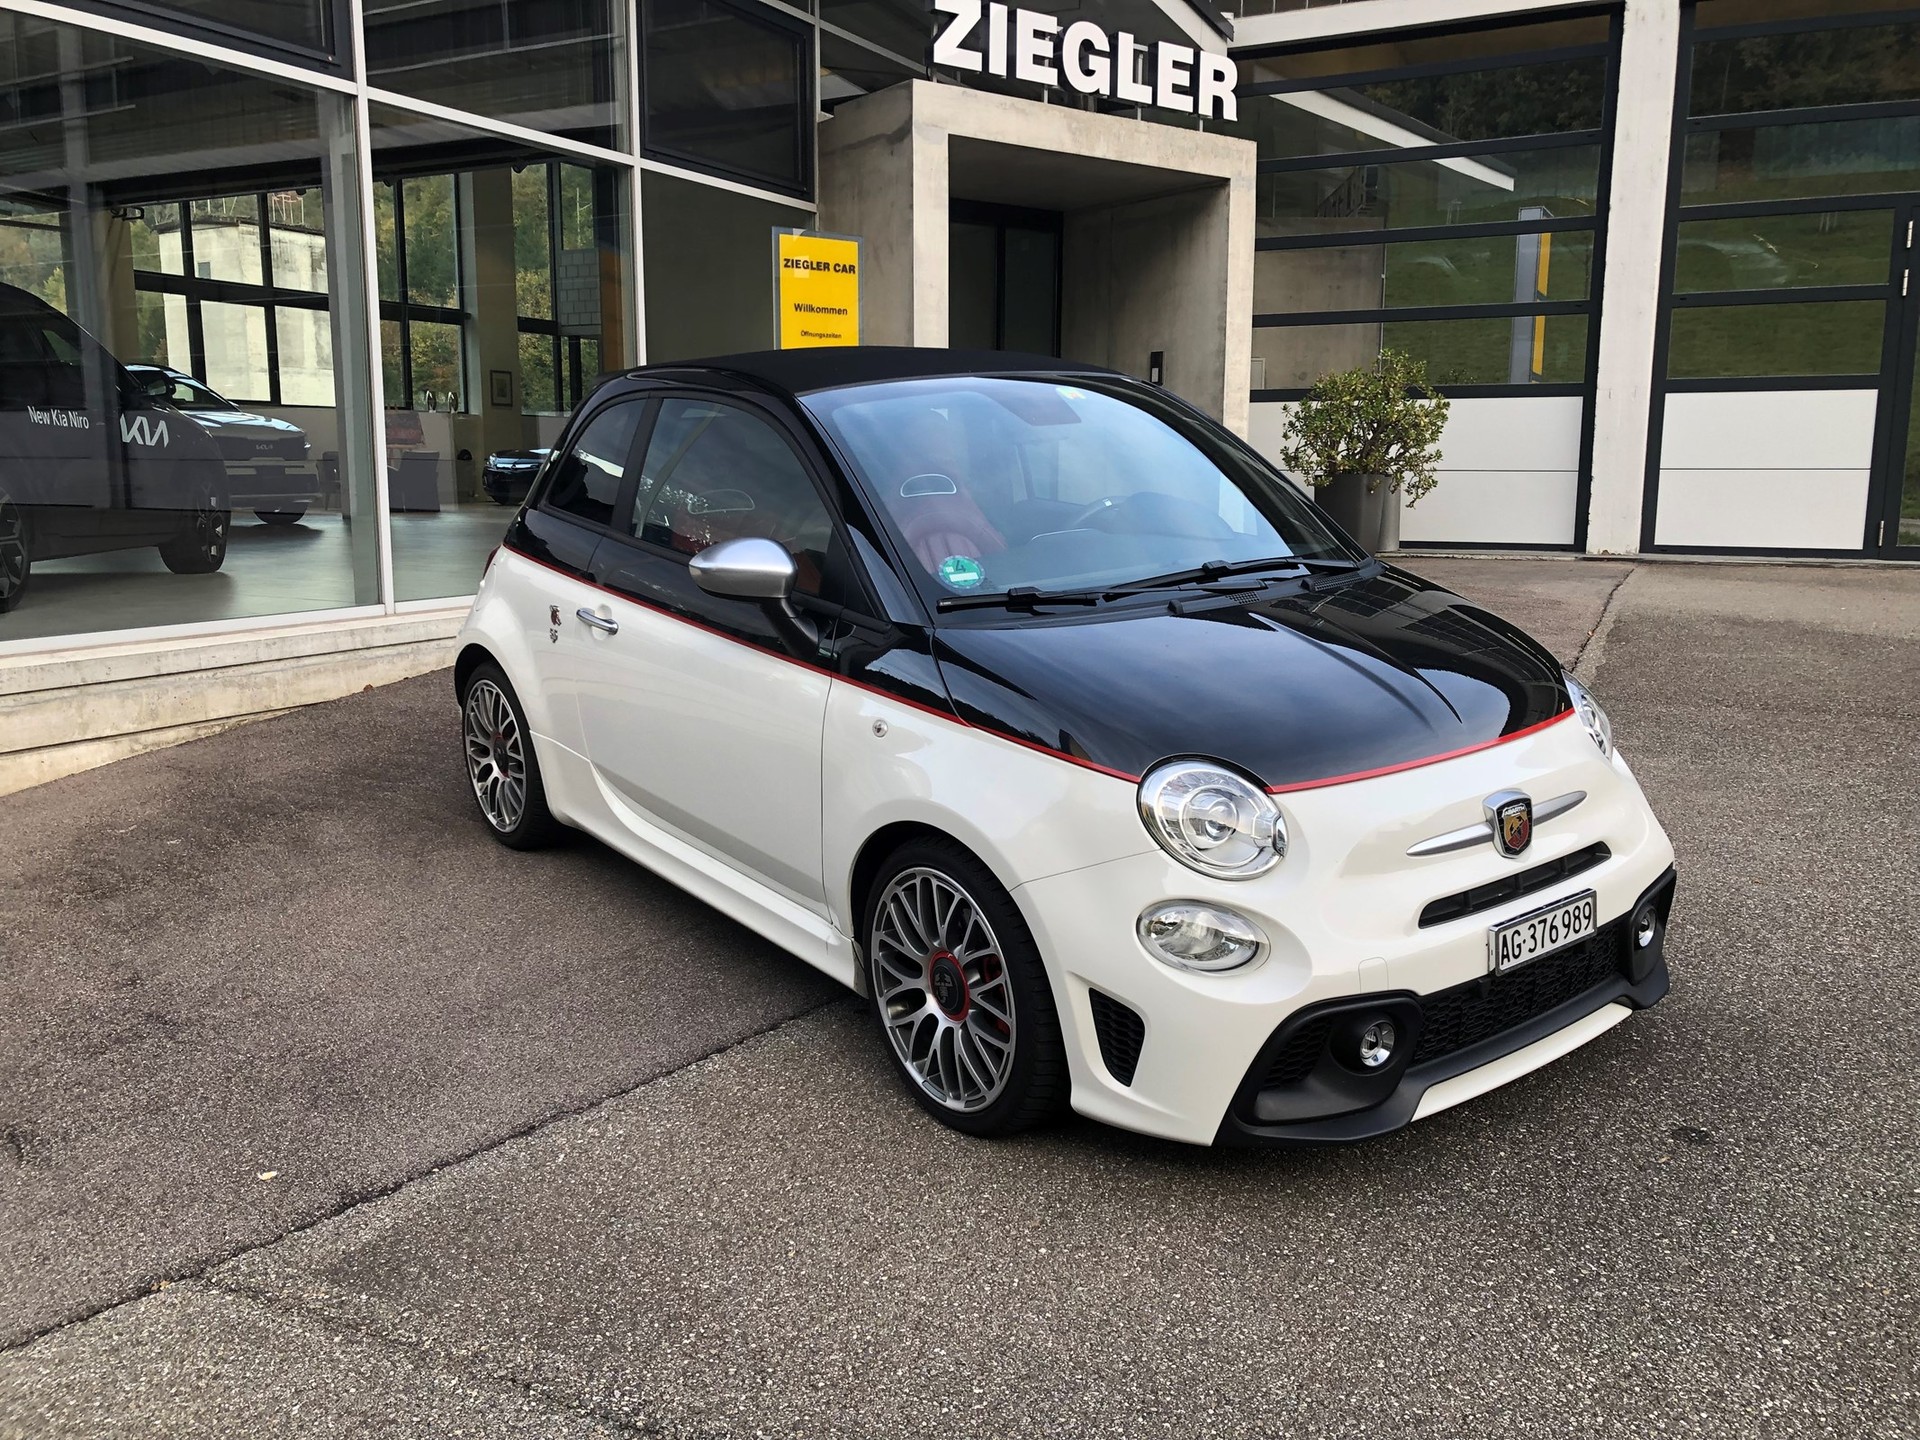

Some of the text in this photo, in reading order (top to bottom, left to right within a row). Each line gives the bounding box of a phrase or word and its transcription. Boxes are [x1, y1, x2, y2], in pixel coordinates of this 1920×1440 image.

[933, 0, 1238, 122] ZIEGLER
[783, 257, 856, 275] ZIEGLER CAR
[793, 303, 848, 315] Willkommen
[27, 404, 90, 429] New Kia Niro
